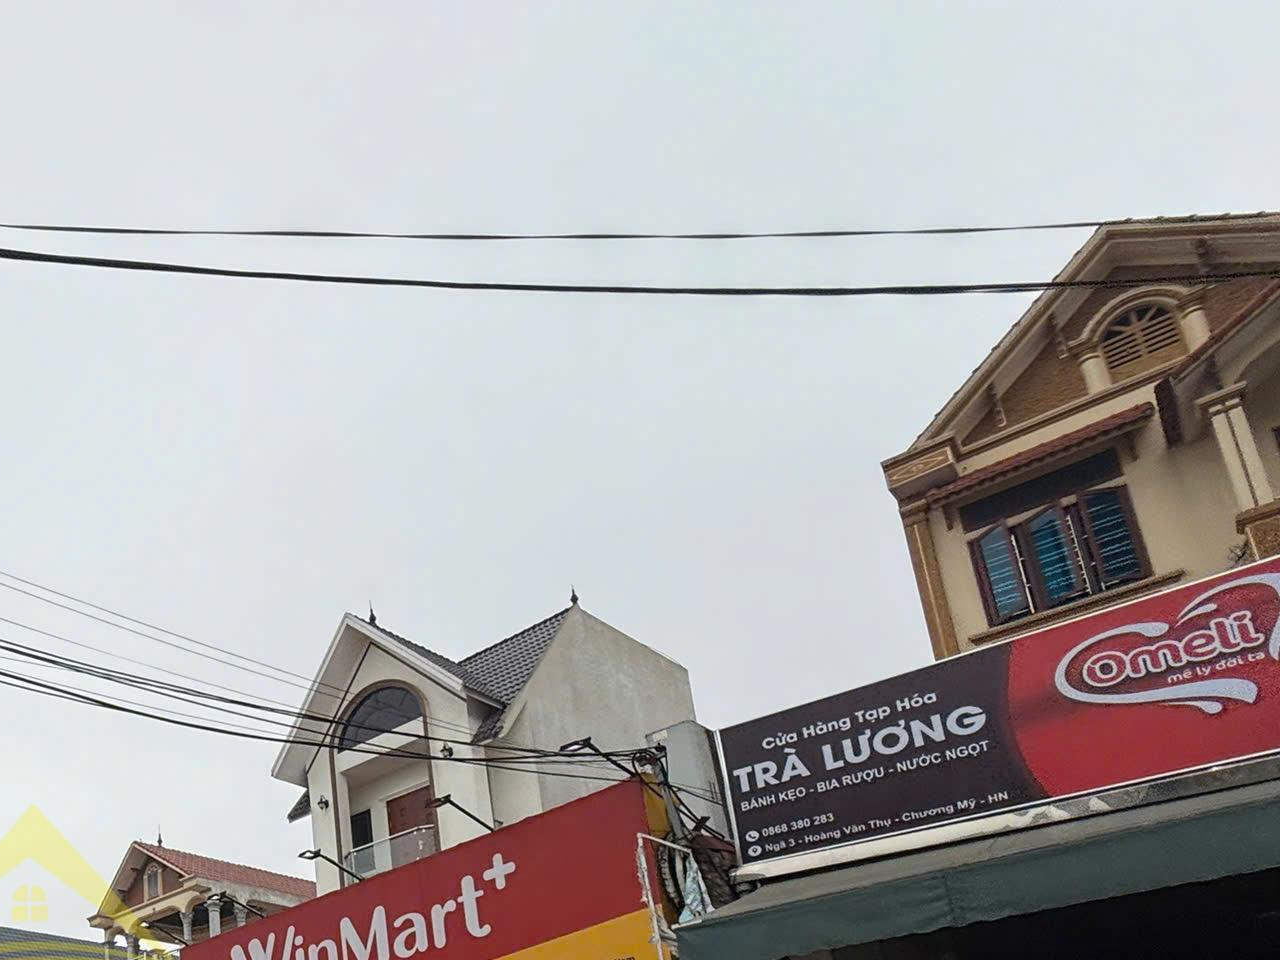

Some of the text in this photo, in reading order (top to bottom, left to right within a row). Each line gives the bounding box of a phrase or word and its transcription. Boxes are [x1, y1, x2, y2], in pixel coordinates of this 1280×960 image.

[733, 705, 986, 793] TRÀ LƯƠNG
[762, 692, 937, 749] Cửa Hàng Tạp Hóa
[740, 794, 776, 812] BÁNH
[779, 787, 806, 802] KẸO
[817, 777, 840, 793] BIA
[842, 766, 885, 786] RƯỢU
[896, 752, 942, 773] NƯỚC
[945, 740, 989, 760] NGỌT
[762, 812, 834, 837] 0868 380 283
[765, 839, 786, 852] Ngã
[788, 839, 795, 847] 3
[804, 829, 841, 843] Hoàng
[843, 824, 866, 835] Văn
[868, 818, 892, 830] Thụ
[902, 804, 954, 822] Chương
[957, 798, 976, 810] Mỹ
[988, 791, 1009, 804] HN
